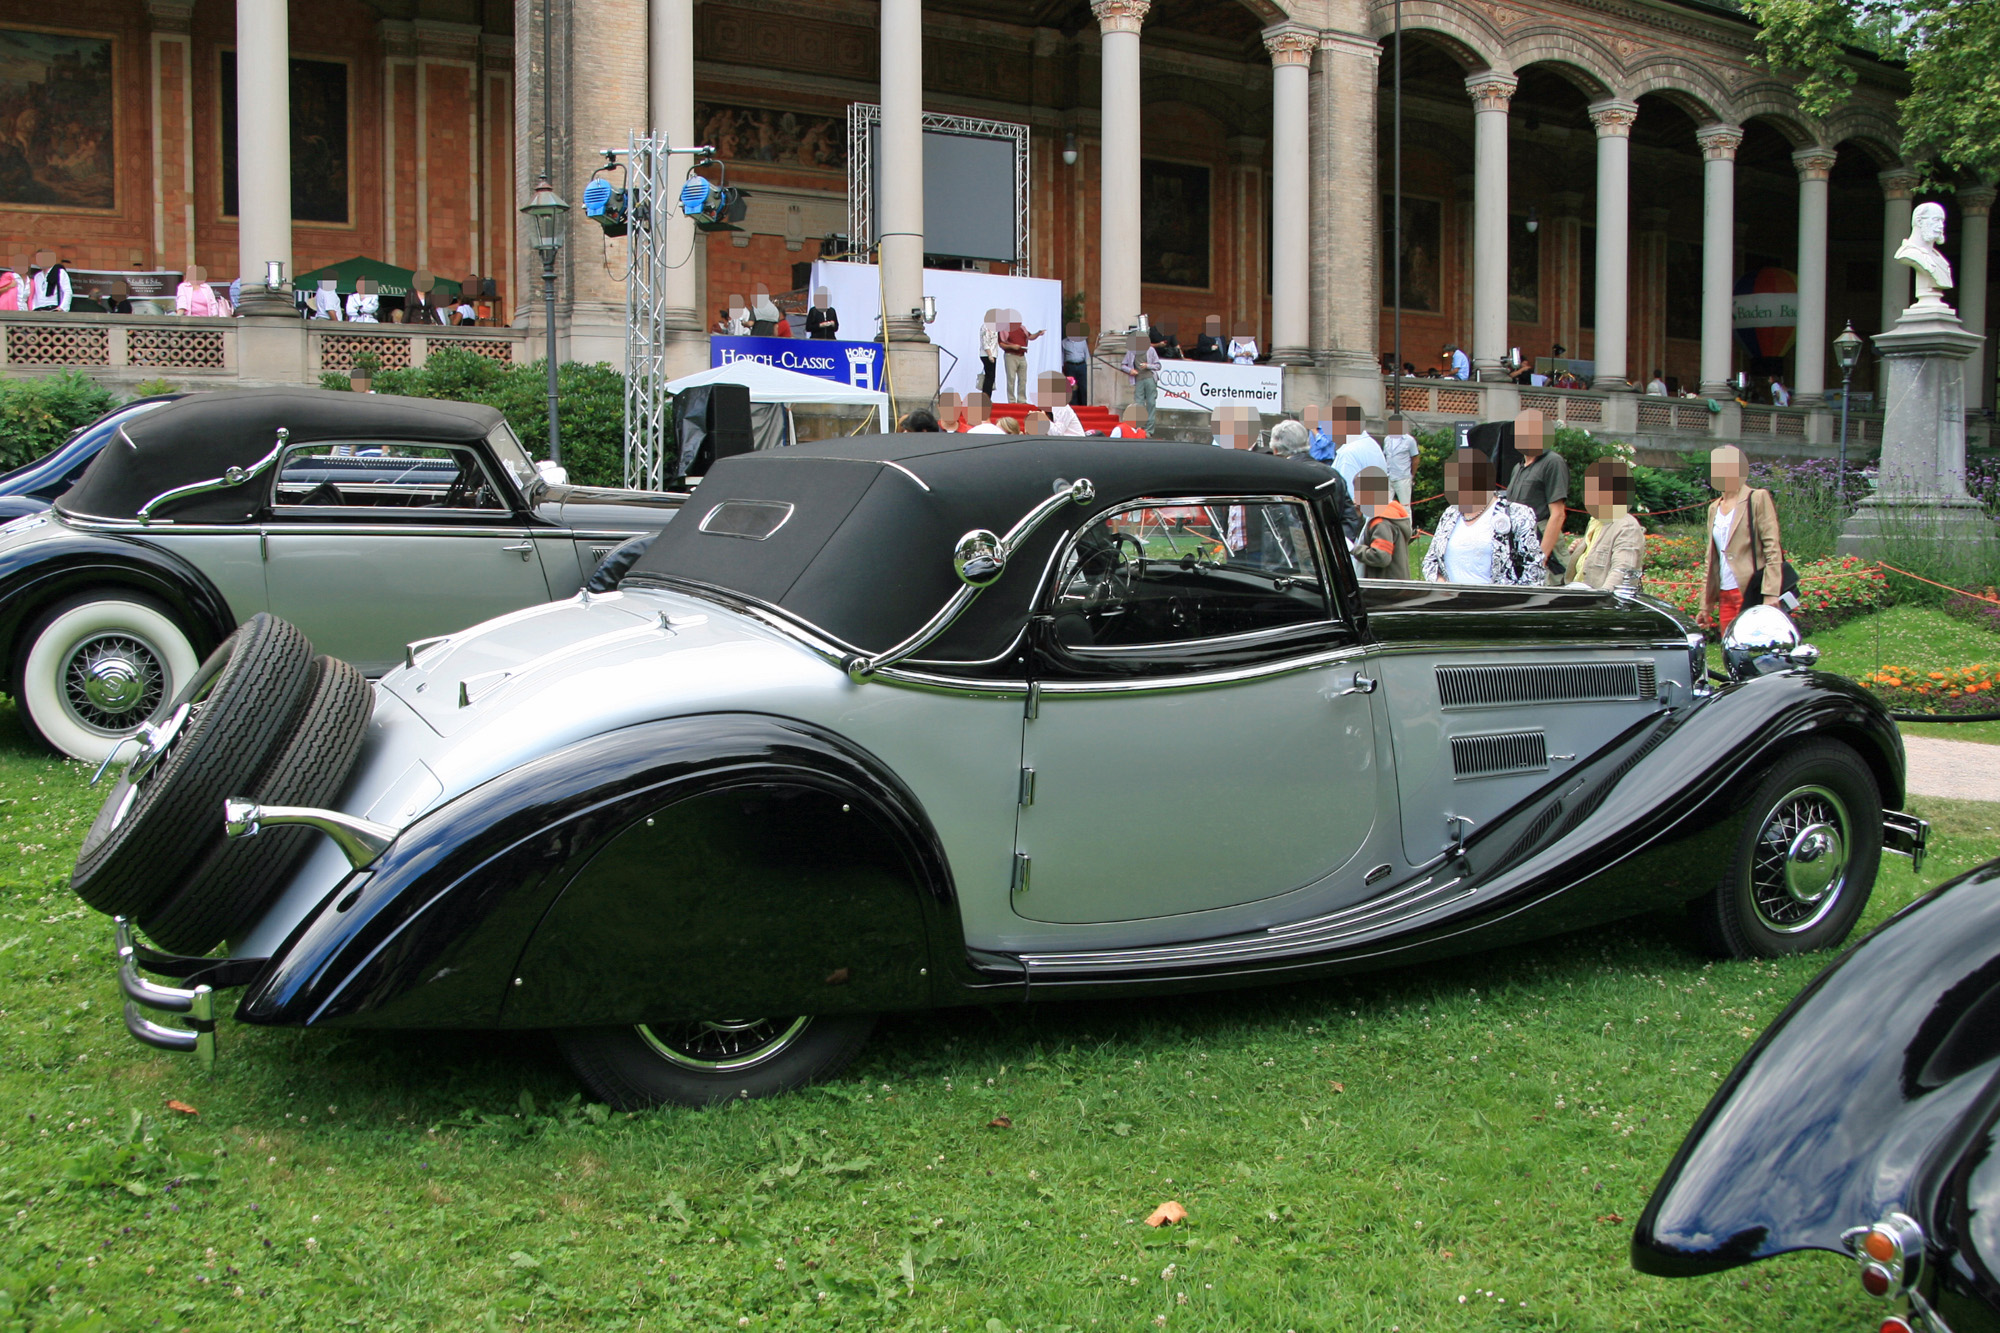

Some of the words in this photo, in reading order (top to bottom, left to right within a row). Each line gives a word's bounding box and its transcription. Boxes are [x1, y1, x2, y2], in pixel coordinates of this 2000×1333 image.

[1737, 304, 1772, 319] Baden
[845, 347, 877, 359] HORCH
[1200, 382, 1278, 400] Gerstenmaier
